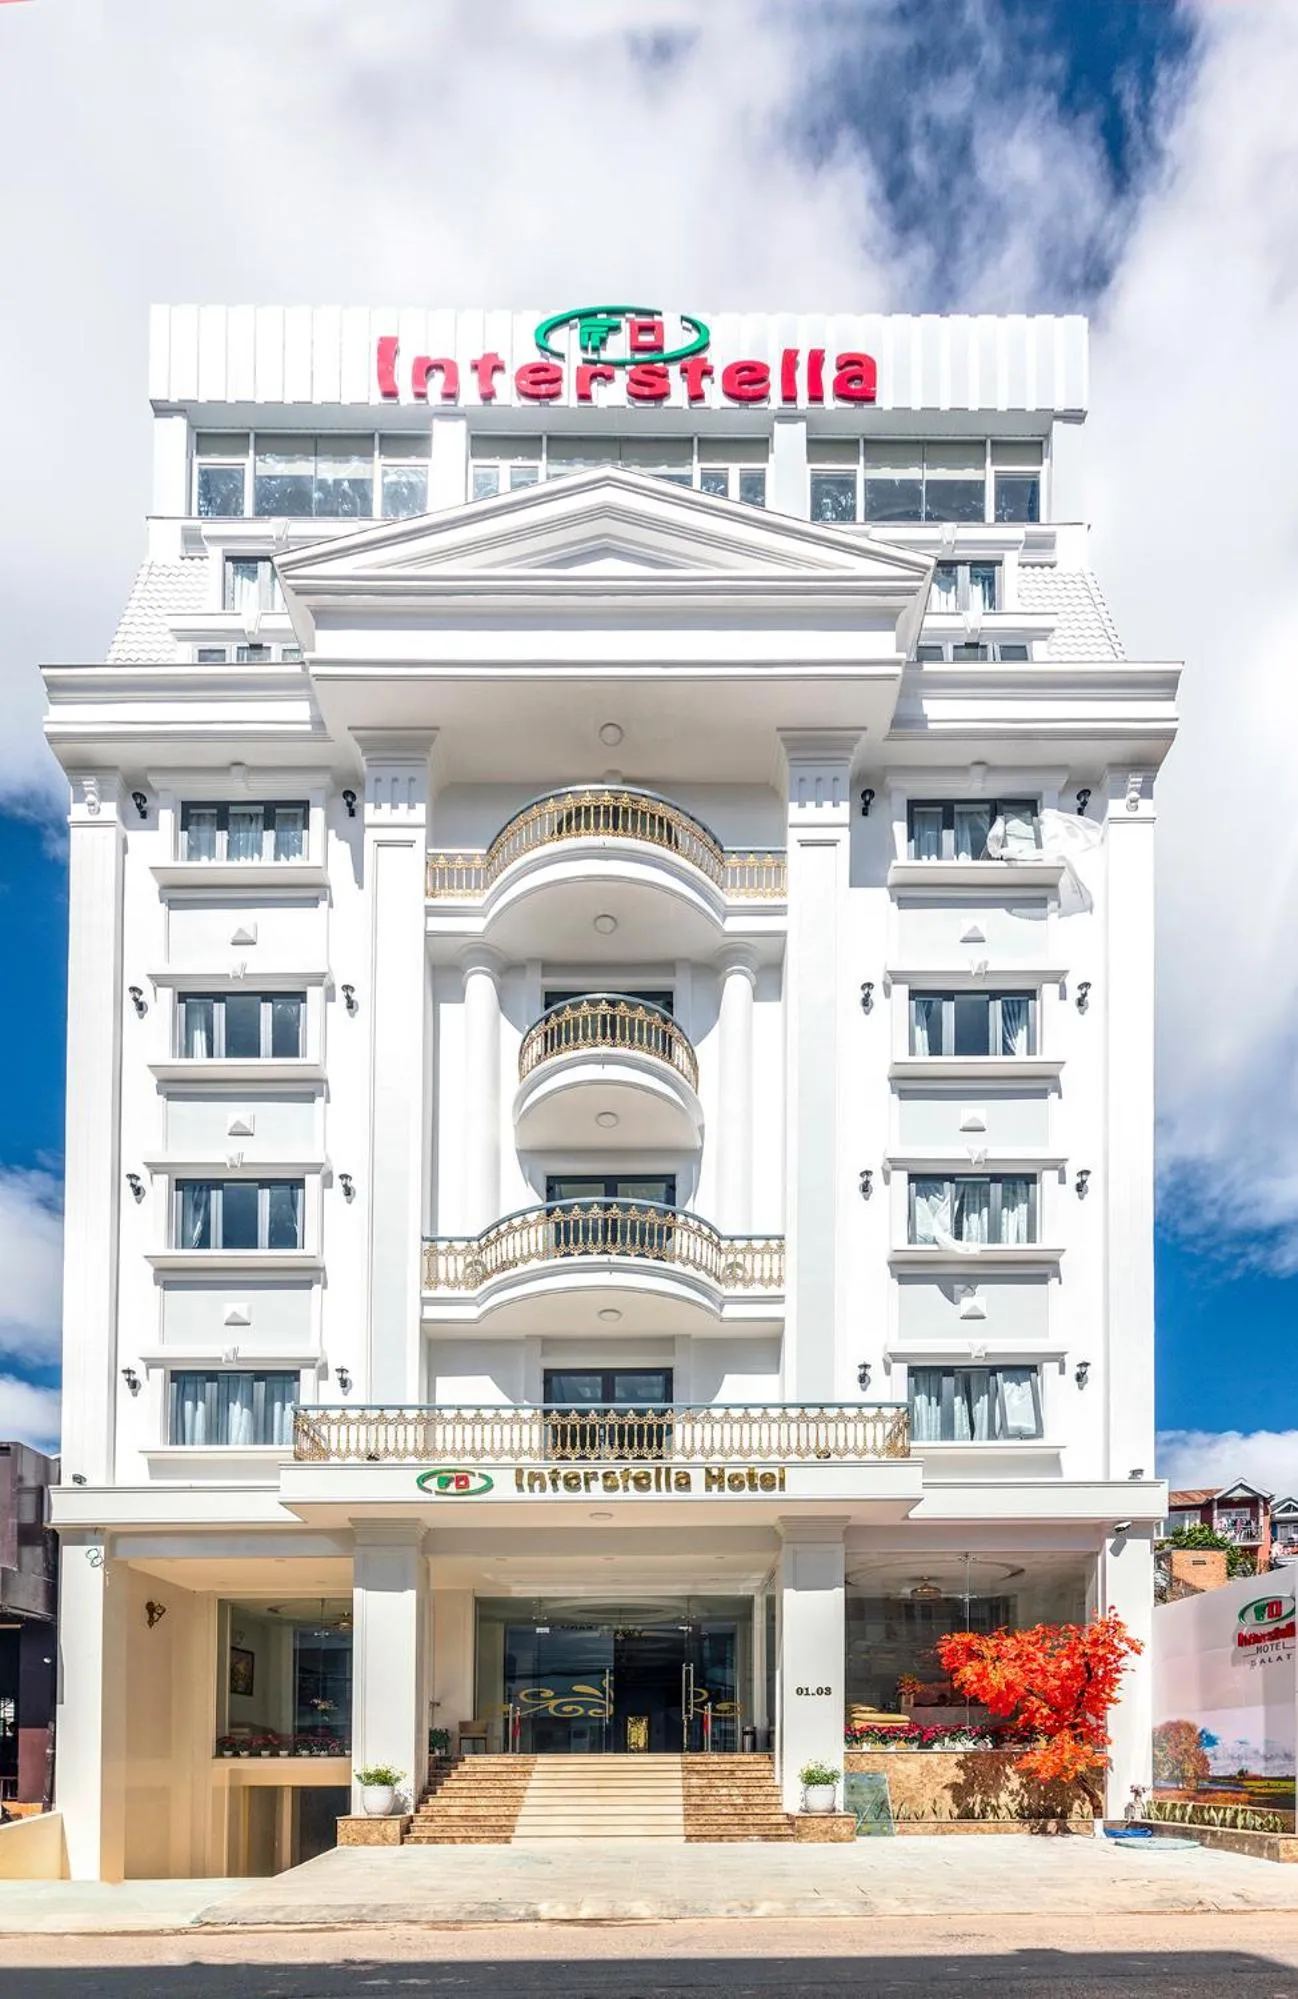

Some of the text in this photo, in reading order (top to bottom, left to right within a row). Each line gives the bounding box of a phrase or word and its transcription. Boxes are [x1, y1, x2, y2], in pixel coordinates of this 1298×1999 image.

[376, 335, 878, 403] Interstella
[515, 1467, 785, 1492] Interstella Hotel
[1256, 1641, 1286, 1654] HOTEL
